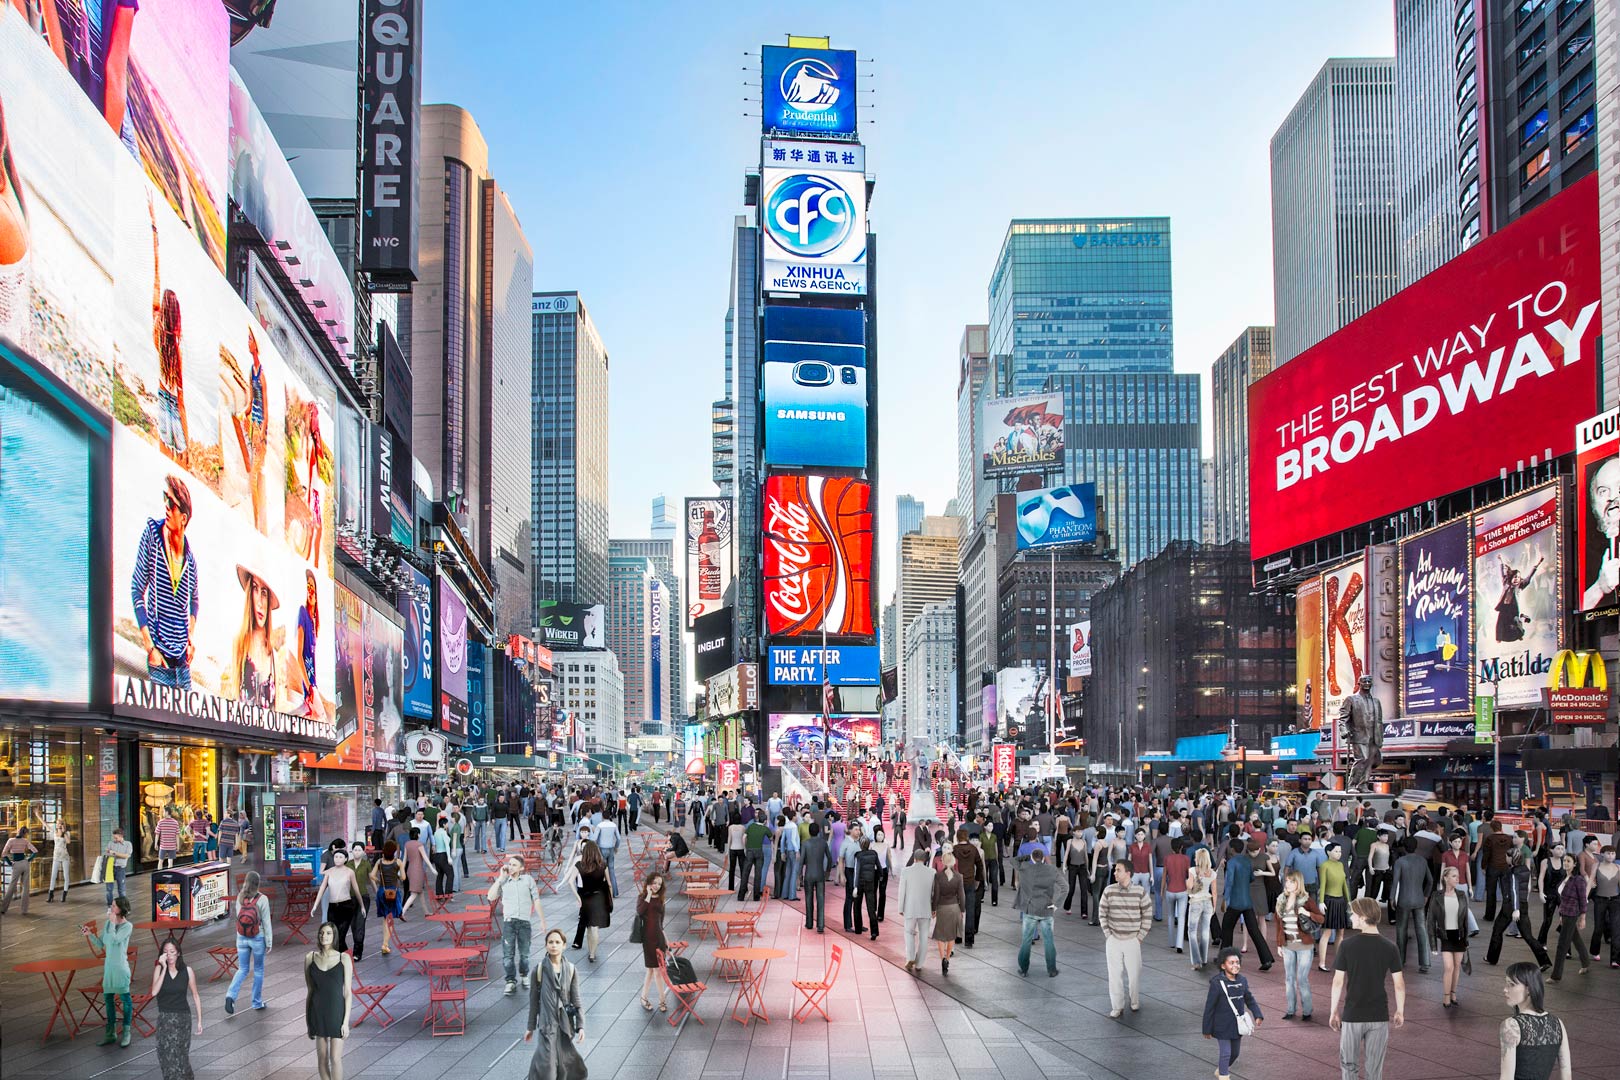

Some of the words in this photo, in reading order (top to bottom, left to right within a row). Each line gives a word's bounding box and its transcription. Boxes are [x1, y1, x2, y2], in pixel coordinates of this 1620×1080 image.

[370, 0, 411, 208] QUARE
[783, 110, 838, 122] Prudential
[773, 148, 855, 165] 新华通讯社
[373, 237, 400, 248] NYC
[1090, 233, 1161, 247] BARCLAYS
[773, 278, 807, 289] NEWS
[810, 280, 858, 291] AGENCY
[786, 265, 845, 280] XINHUA
[1275, 404, 1323, 448] THE
[1331, 362, 1404, 422] BEST
[1412, 313, 1496, 378] WAY
[1507, 280, 1568, 330] TO
[1275, 299, 1601, 492] BROADWAY
[777, 409, 846, 422] SAMSUNG
[1050, 523, 1093, 535] PHANTOM
[1478, 544, 1488, 554] #1
[1488, 536, 1508, 550] Show
[1508, 530, 1518, 541] of
[1517, 526, 1531, 536] the
[1531, 515, 1552, 531] Year!
[1483, 527, 1503, 542] TIME
[1503, 510, 1545, 534] Magazine's
[1406, 567, 1467, 606] American
[652, 590, 661, 636] NOVOTEL
[1415, 590, 1454, 622] Paris
[1380, 555, 1394, 684] PALACE
[697, 637, 726, 654] INGLOT
[773, 650, 796, 664] THE
[801, 650, 841, 664] AFTER
[774, 667, 817, 681] PARTY.
[1478, 649, 1553, 684] Matilda
[746, 664, 757, 710] HELLO!
[1551, 694, 1609, 702] McDonald's
[122, 676, 222, 722] AMERICAN
[226, 698, 265, 728] EAGLE
[266, 712, 338, 741] OUTFITTERS
[723, 762, 737, 787] tkts
